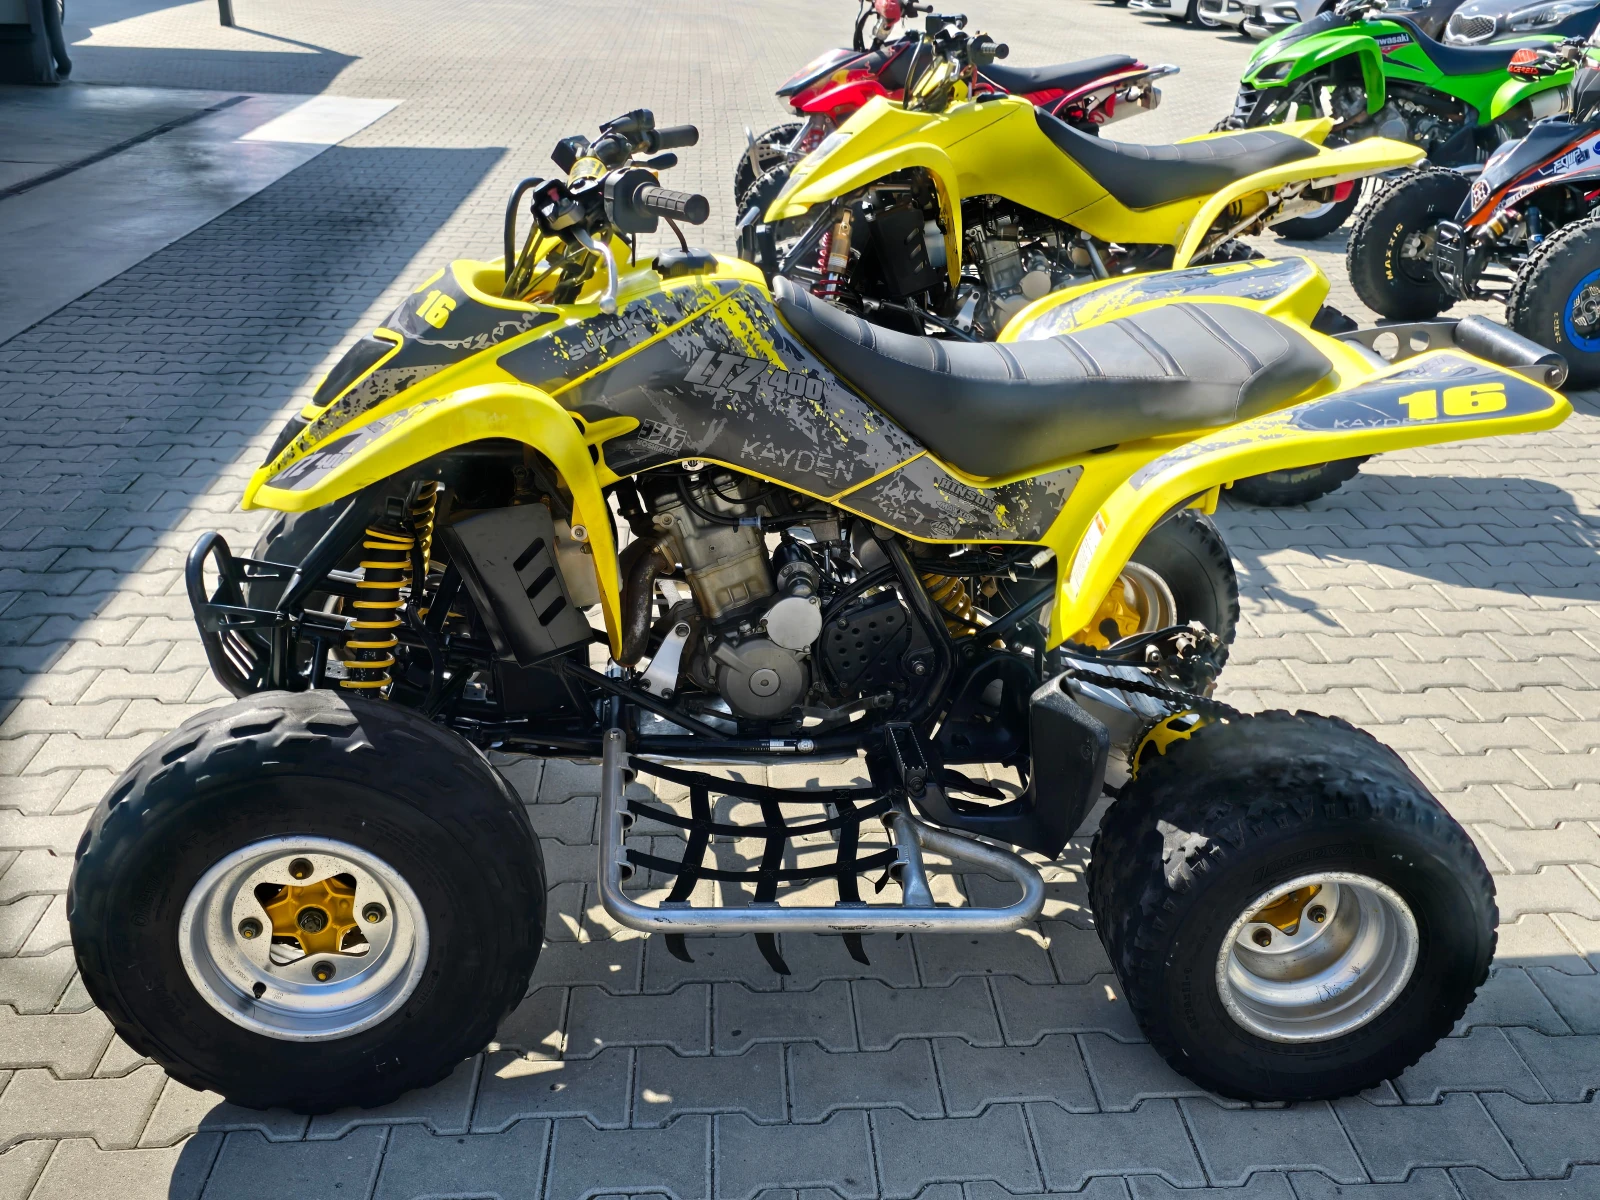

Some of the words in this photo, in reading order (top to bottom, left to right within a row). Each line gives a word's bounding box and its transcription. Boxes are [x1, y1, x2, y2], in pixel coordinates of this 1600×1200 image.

[1379, 33, 1410, 45] wasaki
[1384, 223, 1404, 280] MAXXIS
[416, 289, 457, 329] 16
[567, 305, 651, 362] SUZUKI
[768, 369, 825, 402] 400
[1398, 382, 1508, 421] 16
[740, 438, 855, 483] KAYDEN
[939, 477, 997, 514] HINSON
